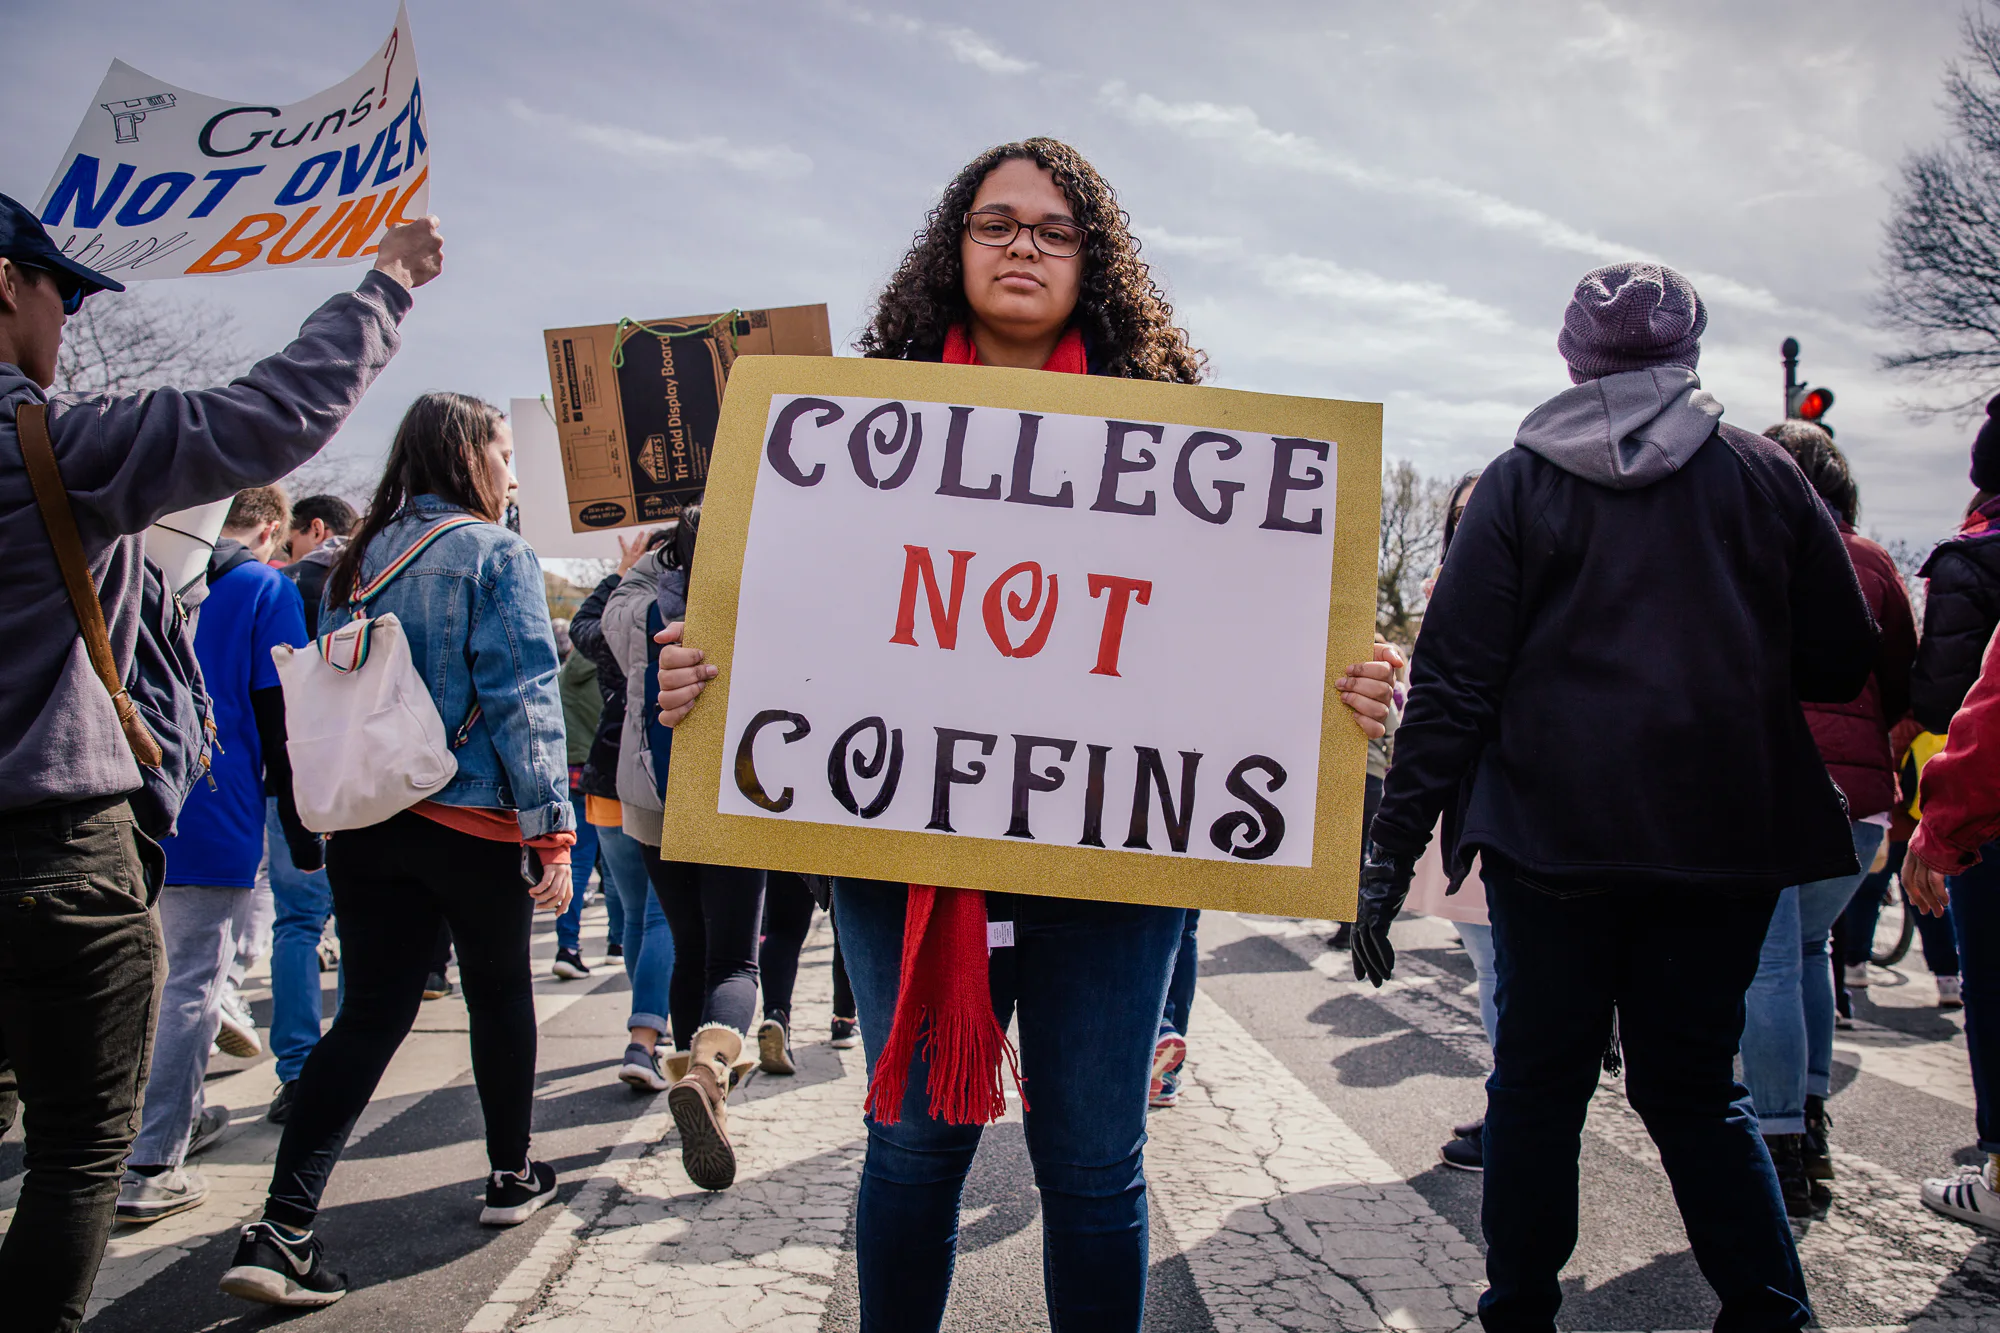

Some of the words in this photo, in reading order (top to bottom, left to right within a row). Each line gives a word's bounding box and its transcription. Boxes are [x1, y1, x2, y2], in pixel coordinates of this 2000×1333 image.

[41, 153, 267, 229] NOT
[274, 77, 427, 206] OVER
[198, 27, 398, 158] Guns?
[657, 336, 675, 376] Board
[665, 378, 682, 427] Display
[653, 437, 667, 480] ELMER'S
[670, 428, 689, 481] Tri-Fold
[767, 397, 1330, 535] COLLEGE
[889, 545, 1152, 677] NOT
[734, 709, 1287, 860] COFFINS
